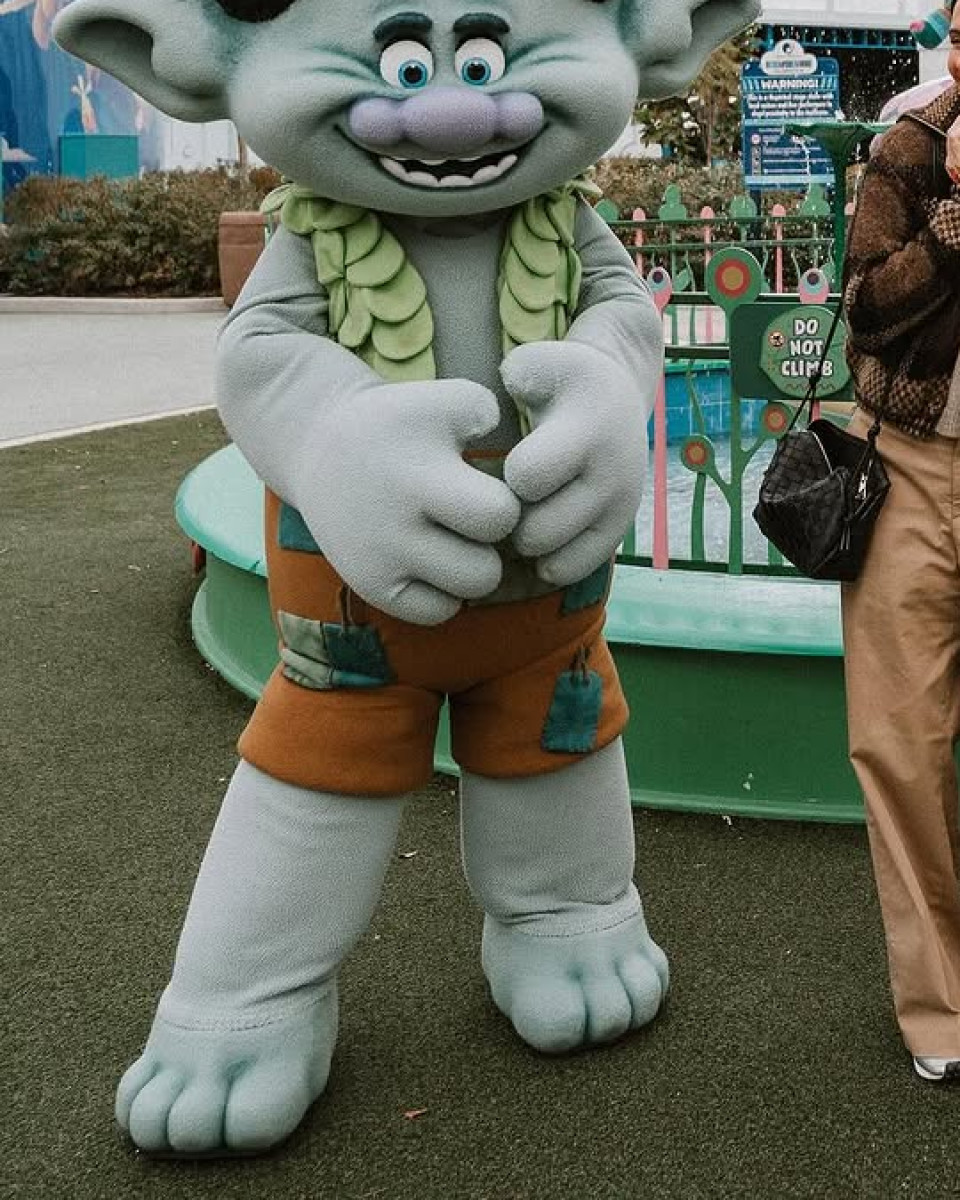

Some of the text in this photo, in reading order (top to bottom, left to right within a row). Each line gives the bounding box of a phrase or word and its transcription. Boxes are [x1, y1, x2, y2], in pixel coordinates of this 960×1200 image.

[761, 79, 818, 90] WARNING!
[794, 319, 819, 335] DO
[790, 340, 824, 356] NOT
[781, 360, 833, 377] CLIMB
